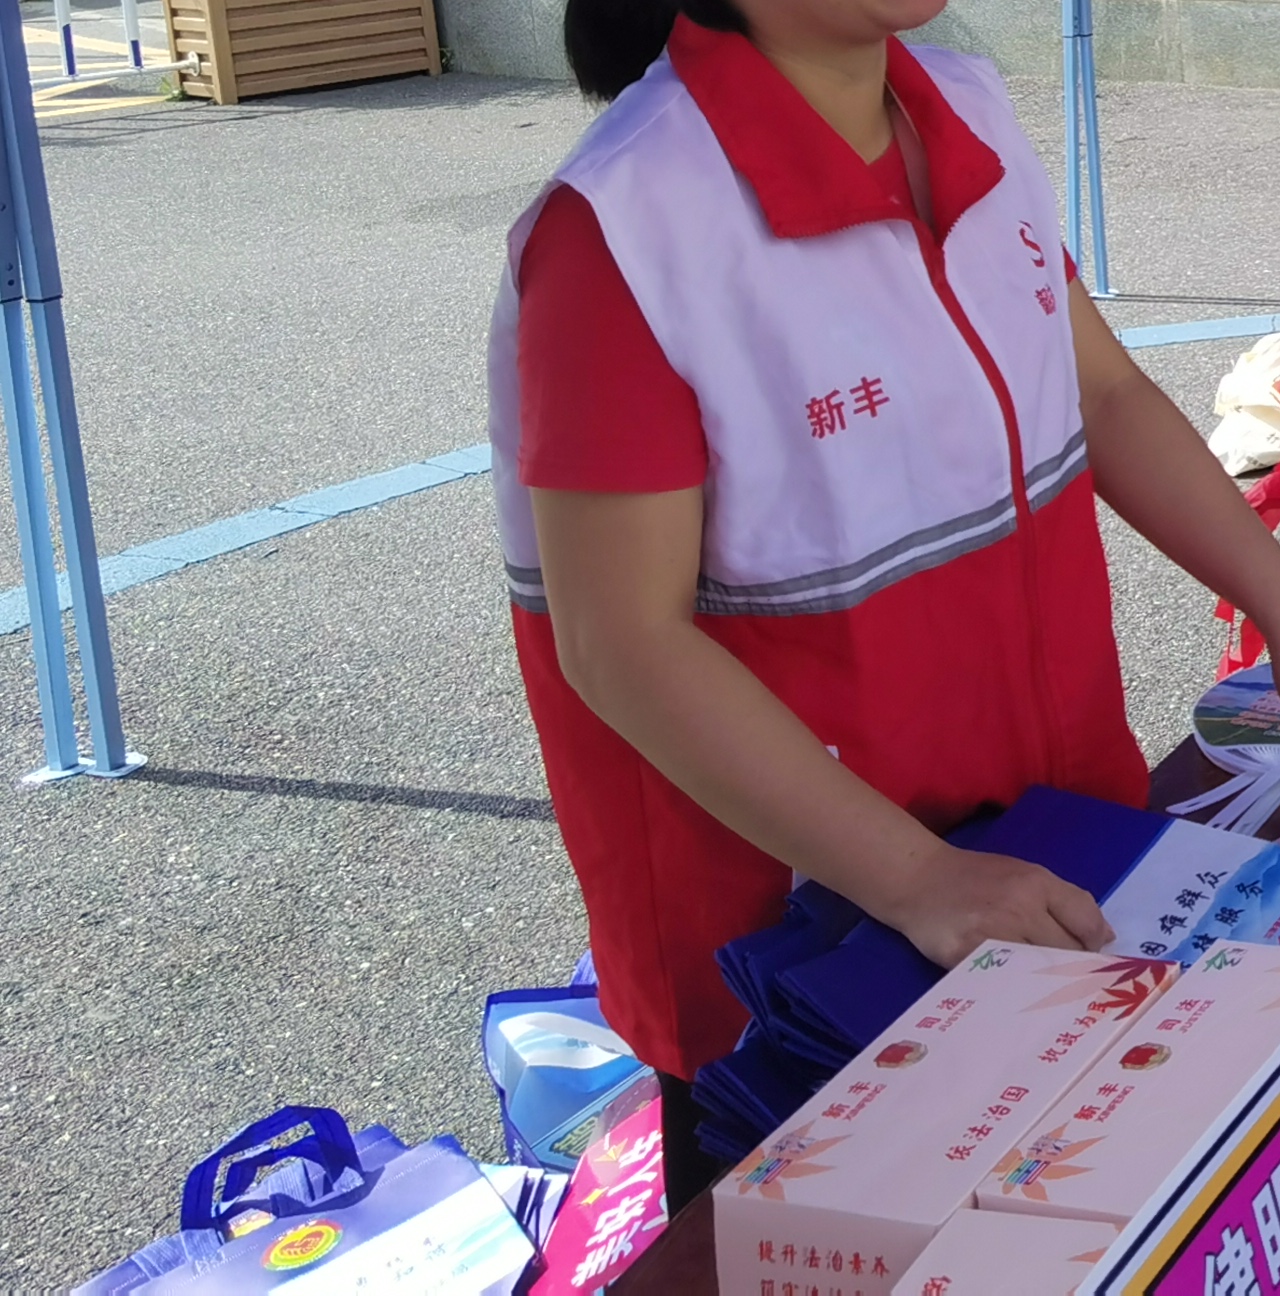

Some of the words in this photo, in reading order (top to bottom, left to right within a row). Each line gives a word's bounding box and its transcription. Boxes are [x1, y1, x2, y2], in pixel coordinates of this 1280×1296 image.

[805, 375, 890, 440] 新丰
[1138, 869, 1229, 957] 困难群众
[915, 996, 964, 1030] 司法
[938, 998, 976, 1032] JUSTICE
[1155, 997, 1202, 1032] 司法
[821, 1080, 872, 1121] 新丰
[1073, 1081, 1120, 1123] 新丰
[944, 1084, 1030, 1163] 依法治国
[757, 1239, 890, 1278] 提升法治素养
